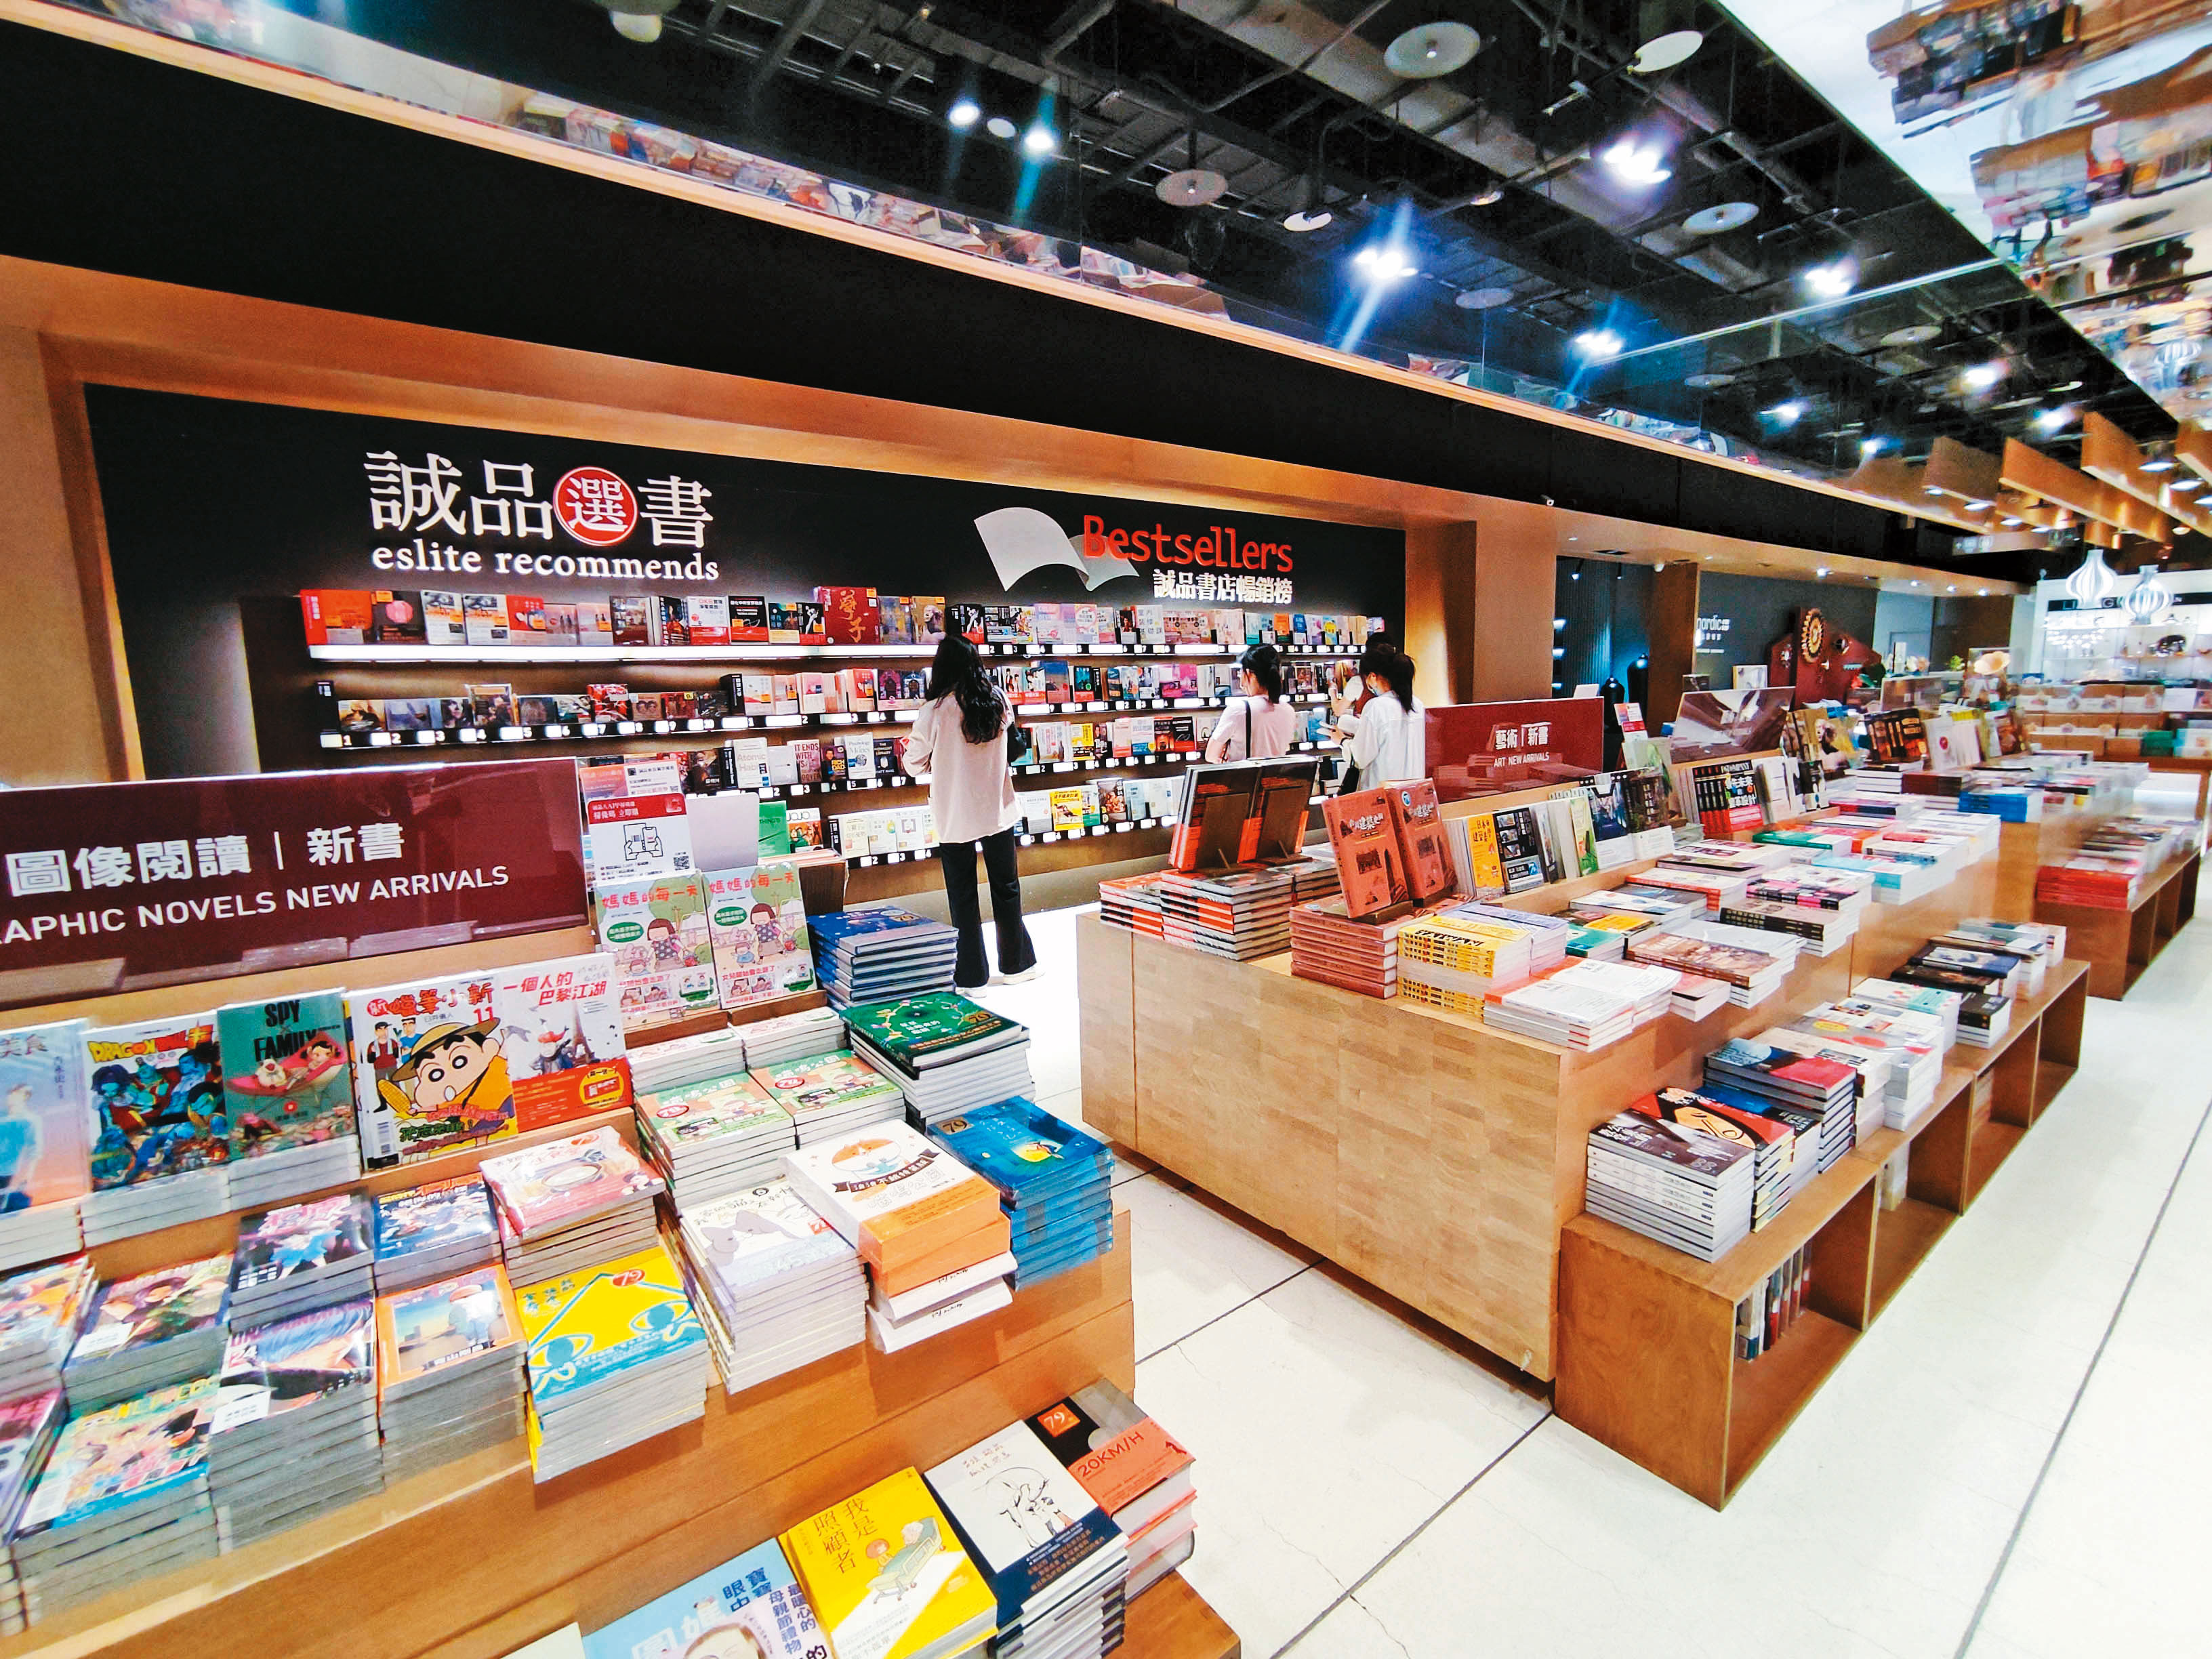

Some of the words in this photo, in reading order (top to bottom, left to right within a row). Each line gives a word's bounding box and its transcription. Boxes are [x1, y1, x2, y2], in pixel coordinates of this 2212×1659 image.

[363, 450, 714, 548] 誠品選書
[1084, 514, 1293, 572] Bestsellers
[372, 539, 482, 573] eslite
[495, 552, 719, 581] recommends
[1152, 569, 1293, 604] 誠品書店暢銷榜
[748, 718, 754, 726] 1
[802, 716, 808, 724] 2
[851, 714, 858, 722] 3
[879, 712, 886, 721] 4
[523, 727, 532, 737] 5
[562, 726, 570, 736] 6
[598, 724, 606, 735] 7
[635, 722, 643, 733] 8
[669, 721, 676, 731] 9
[343, 735, 352, 745] 1
[391, 733, 401, 744] 2
[435, 731, 445, 741] 3
[476, 729, 487, 740] 4
[1495, 729, 1518, 750] 藝術
[1528, 726, 1549, 746] 新書
[802, 743, 819, 752] ENDS
[795, 752, 812, 760] WITH
[1494, 757, 1506, 767] ART
[1509, 755, 1522, 765] NEW
[1522, 752, 1549, 764] ARRIVALS
[877, 778, 882, 786] 6
[901, 777, 906, 785] 7
[773, 787, 779, 796] 2
[803, 785, 810, 793] 3
[5, 834, 252, 898] 圖像閱讀
[307, 822, 405, 867] 新書
[872, 857, 878, 865] 2
[899, 853, 905, 861] 3
[709, 872, 796, 894] 媽媽的每一天
[602, 884, 698, 909] 媽媽的每一天
[0, 908, 127, 946] APHIC
[139, 891, 277, 928] NOVELS
[287, 881, 361, 912] NEW
[369, 865, 510, 901] ARRIVALS
[504, 972, 574, 994] 一個人的
[539, 981, 608, 1006] 巴黎江湖
[264, 999, 300, 1027] SPY
[87, 1038, 157, 1063] DRAGON
[943, 1120, 968, 1134] 79
[617, 1270, 642, 1286] 79
[1044, 1411, 1067, 1429] 79
[1078, 1431, 1145, 1477] 20KM/H
[842, 1498, 879, 1540] 我是
[813, 1510, 857, 1574] 照顧者
[768, 1590, 802, 1655] 母親節禮物
